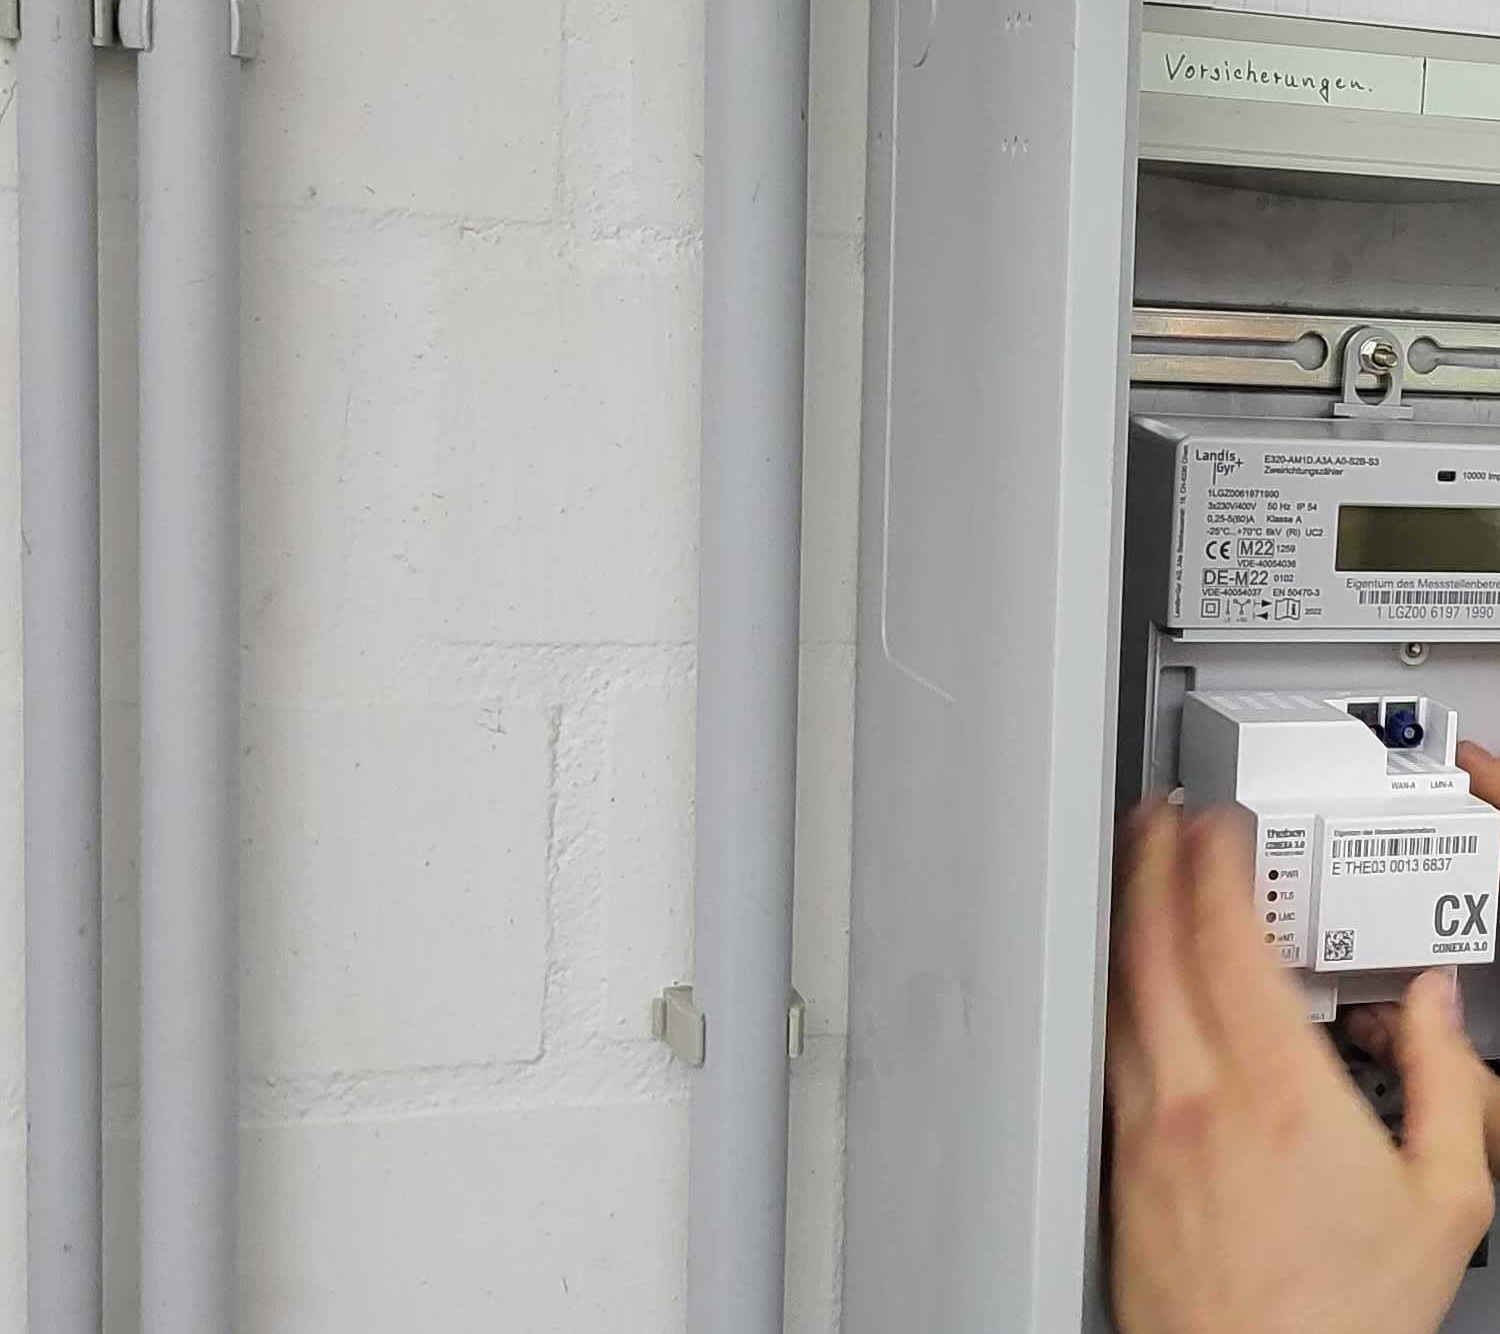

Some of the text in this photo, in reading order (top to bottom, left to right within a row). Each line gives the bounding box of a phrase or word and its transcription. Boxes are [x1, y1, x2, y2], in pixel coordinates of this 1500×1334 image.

[1264, 466, 1343, 477] Zweirichtungszähler
[1462, 471, 1486, 481] 10000
[1267, 502, 1277, 511] 50
[1279, 502, 1291, 511] Hz
[1296, 502, 1305, 511] IP
[1307, 503, 1317, 512] 54
[1266, 515, 1293, 524] Klasse
[1305, 529, 1324, 537] UC2
[1240, 540, 1274, 557] M22
[1203, 569, 1269, 586] DE-M22
[1346, 578, 1394, 590] Eigentum
[1396, 579, 1415, 588] des
[1272, 588, 1285, 597] EN
[1388, 606, 1427, 619] LGZ00
[1430, 606, 1460, 619] 6197
[1465, 606, 1494, 619] 1990
[1391, 780, 1416, 790] WAN-A
[1333, 857, 1453, 875] E THE03 0013 6837
[1434, 894, 1489, 937] CX
[1432, 942, 1488, 954] CONEXA 3.0
